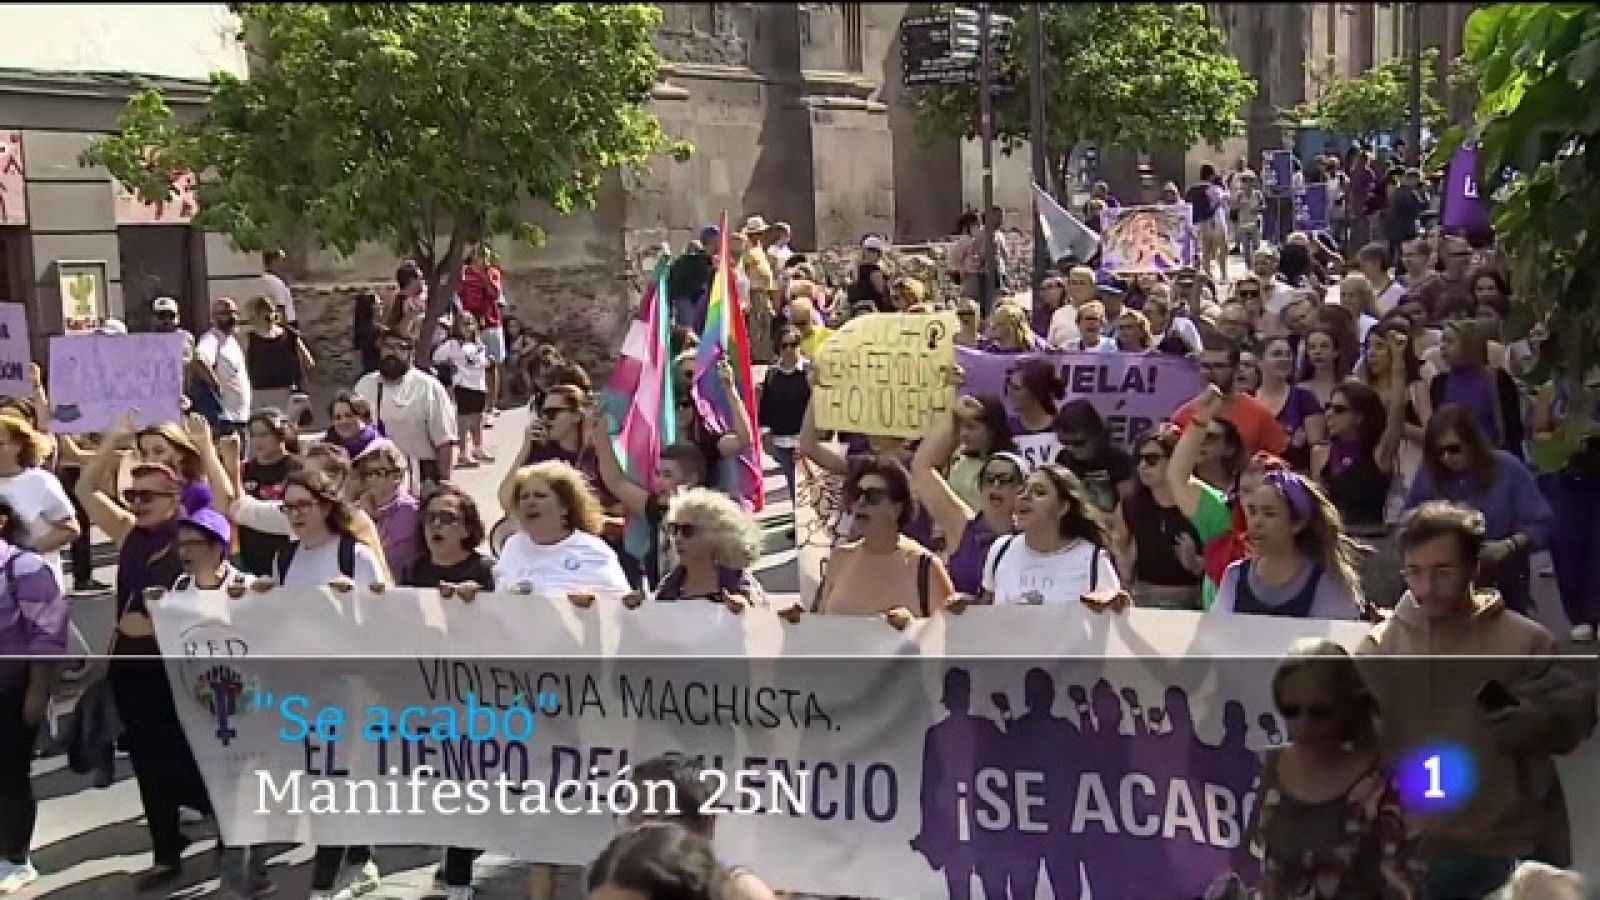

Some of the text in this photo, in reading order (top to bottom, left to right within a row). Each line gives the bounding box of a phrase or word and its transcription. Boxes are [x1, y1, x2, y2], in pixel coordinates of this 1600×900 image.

[417, 657, 842, 732] VIOLENCIA MACHISTA.
[304, 724, 350, 776] EL
[370, 724, 529, 795] TIEMPO
[663, 751, 899, 823] LENCIO
[956, 766, 1261, 849] ¡SE ACAB
